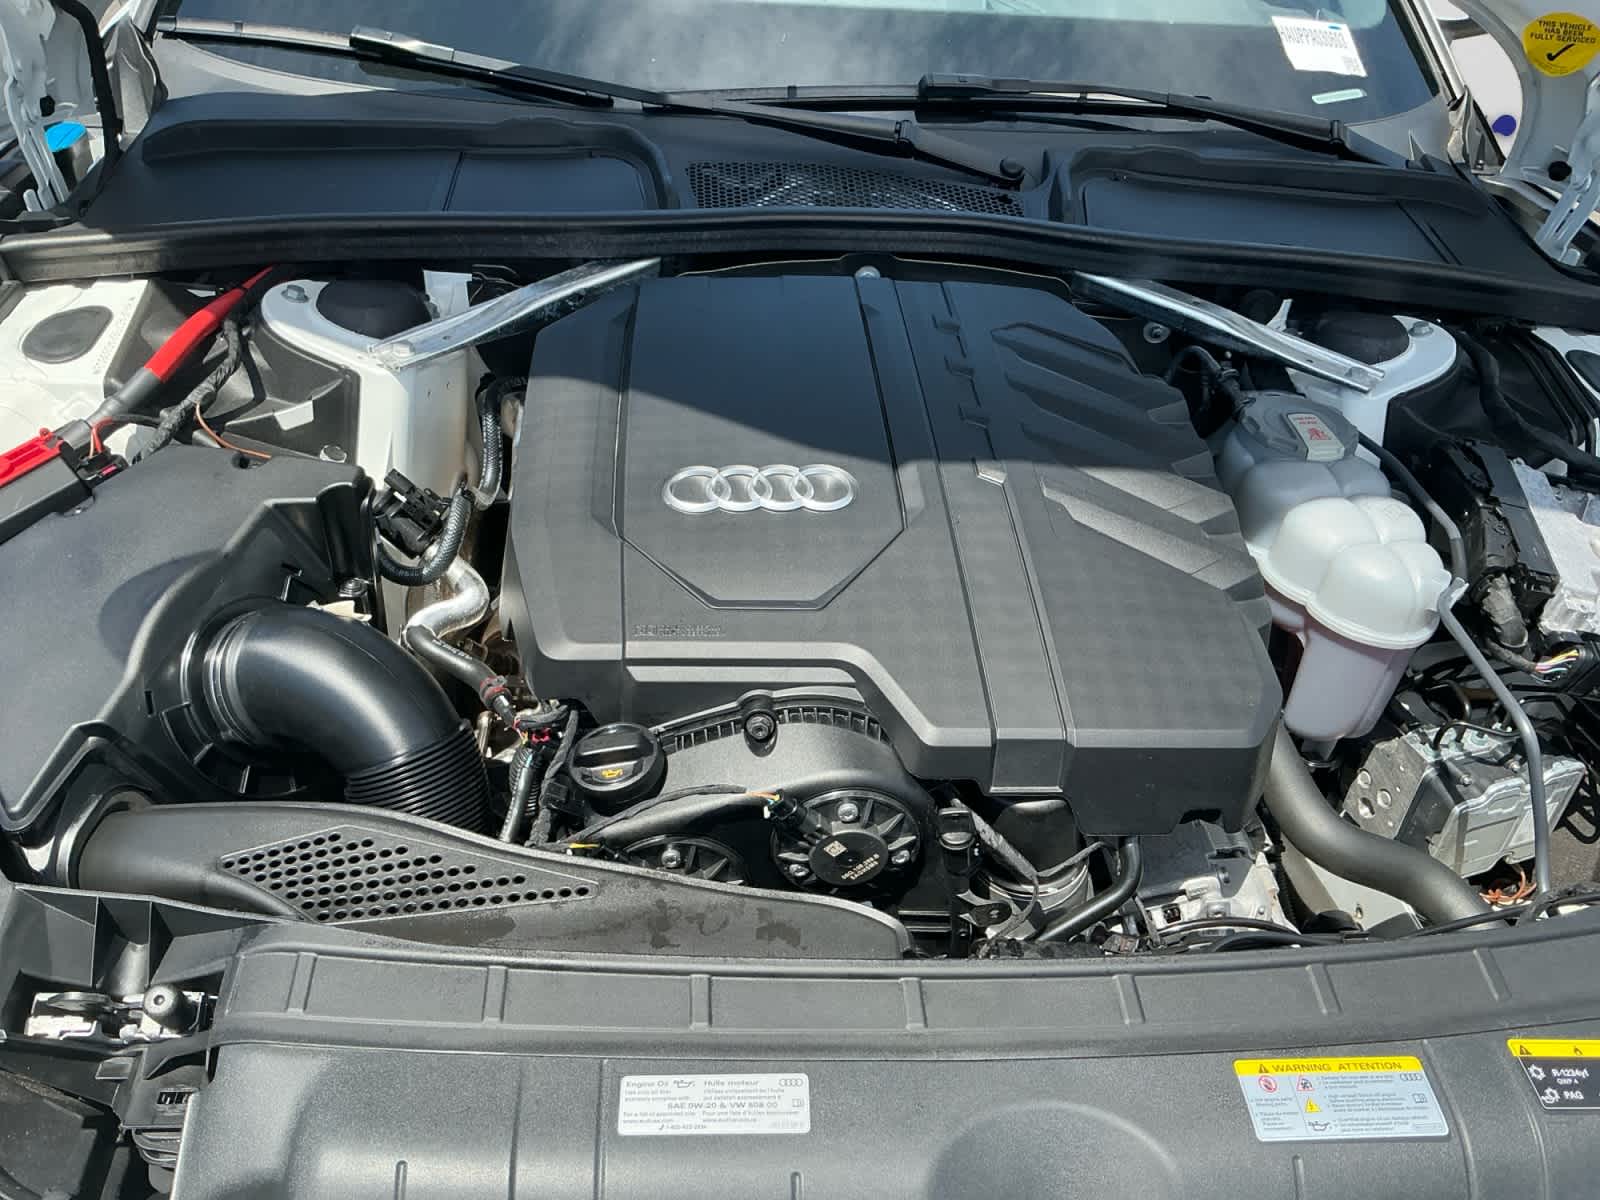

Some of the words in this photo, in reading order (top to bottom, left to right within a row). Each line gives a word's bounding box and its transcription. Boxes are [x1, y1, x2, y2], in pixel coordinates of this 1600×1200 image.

[1559, 21, 1593, 31] VEHICLE
[1530, 32, 1554, 40] FULLY
[1557, 35, 1596, 44] SERVICED
[1272, 1063, 1332, 1073] WARNING
[1338, 1061, 1402, 1071] ATTENTION
[626, 1080, 655, 1088] Engine
